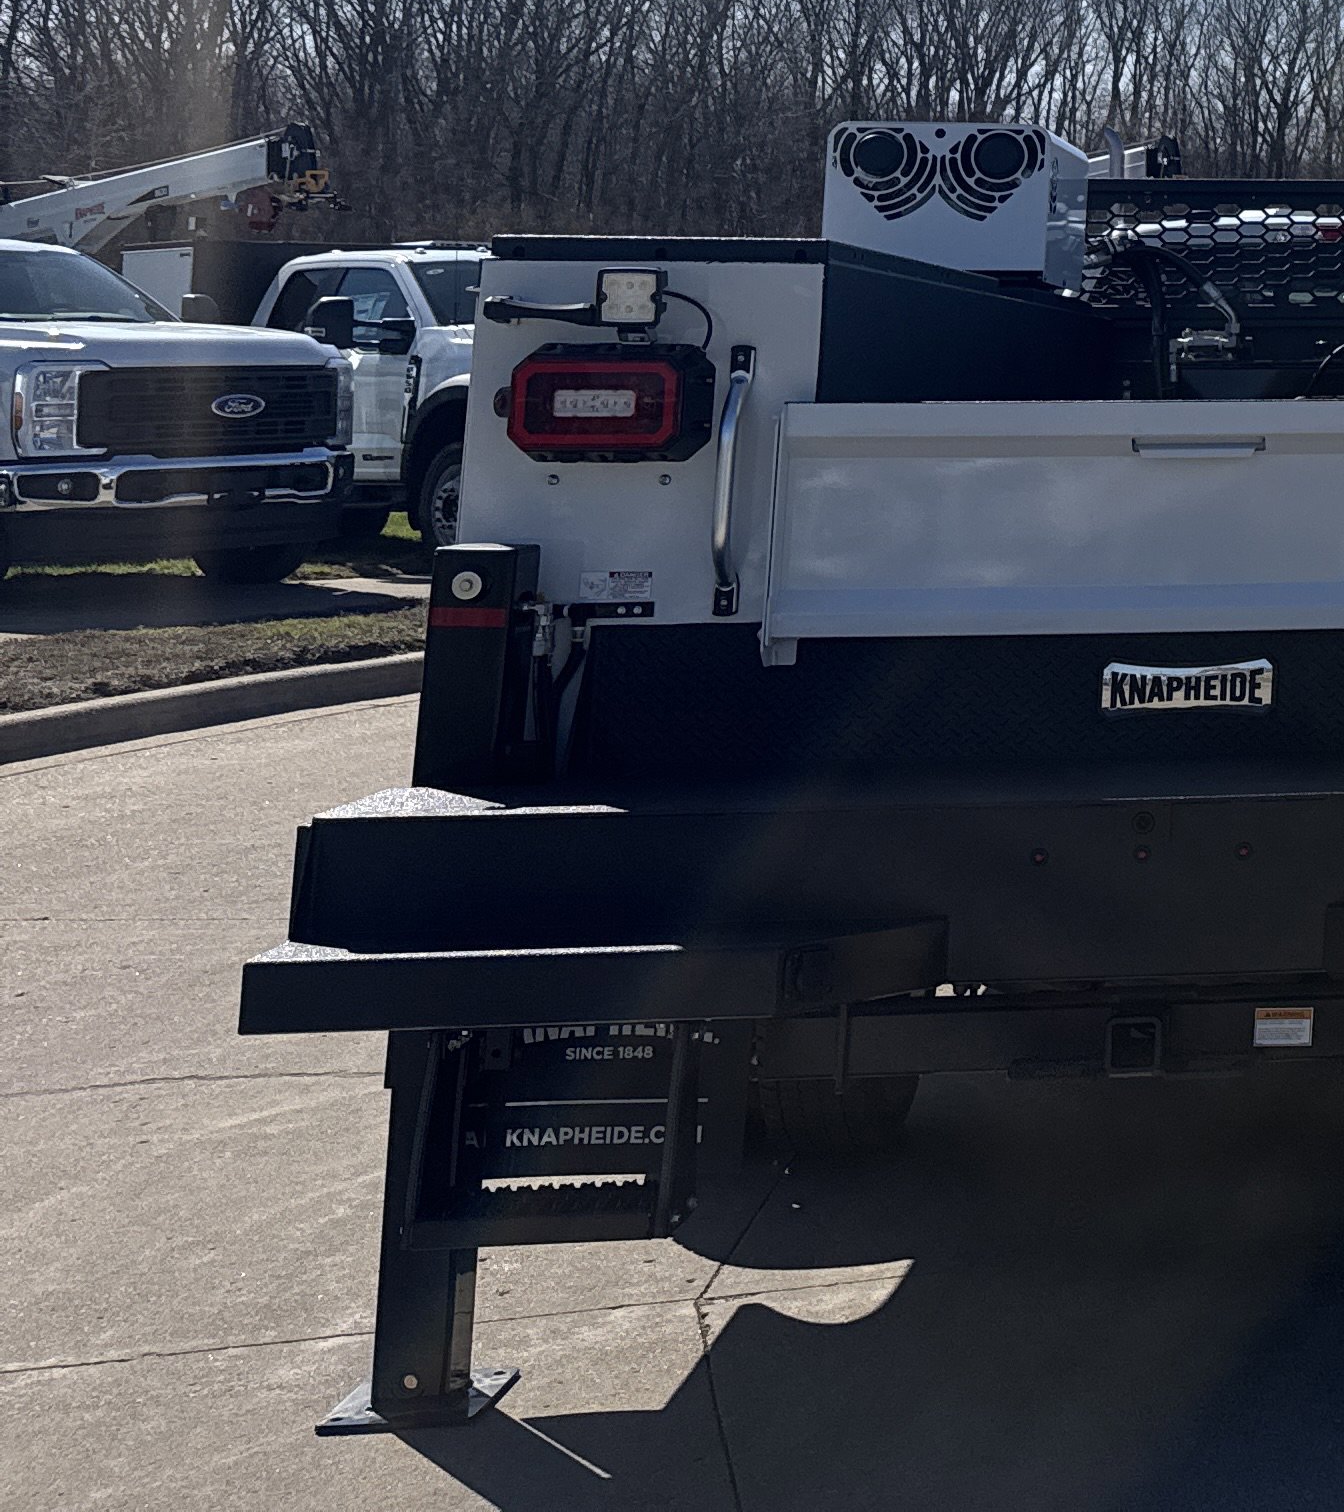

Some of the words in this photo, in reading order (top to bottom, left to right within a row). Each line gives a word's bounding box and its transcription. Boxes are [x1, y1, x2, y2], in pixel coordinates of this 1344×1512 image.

[224, 398, 254, 413] Ford
[1110, 667, 1265, 709] KNAPHEIDE
[565, 1046, 614, 1061] SINCE
[617, 1045, 654, 1059] 1848
[505, 1124, 703, 1148] KNAPHEIDE.C
